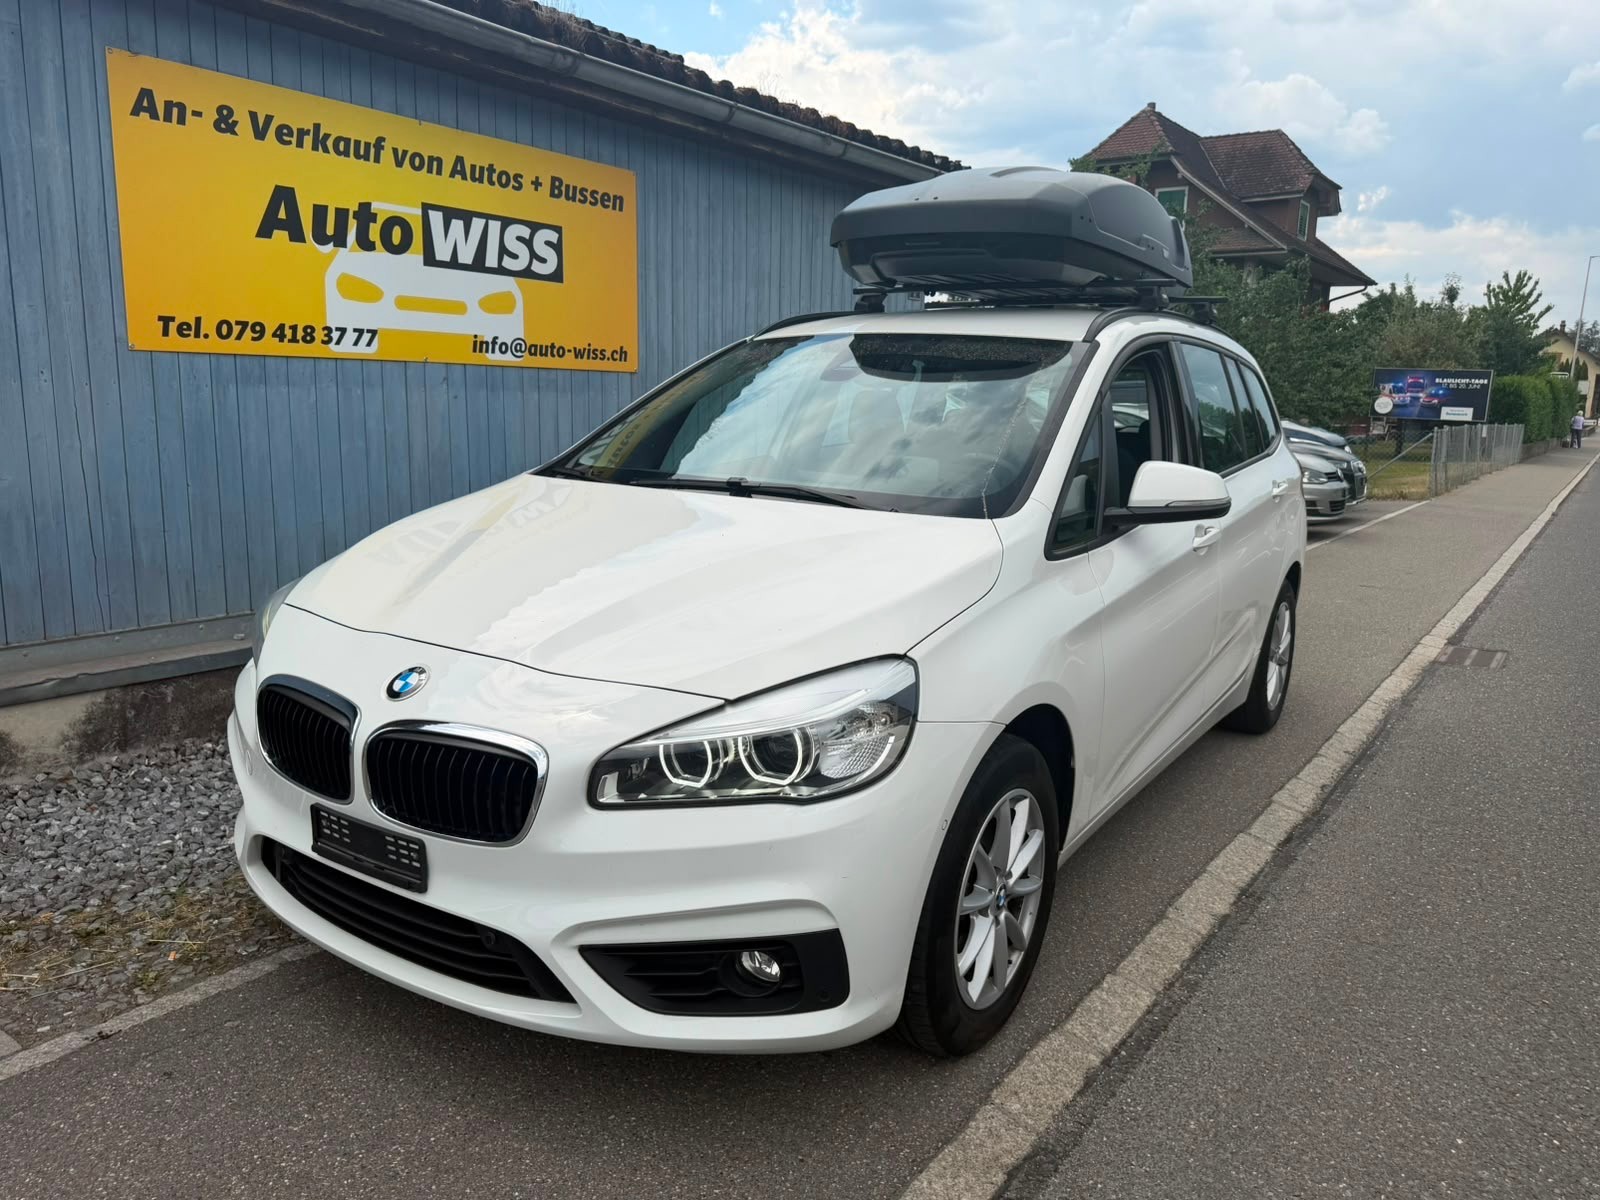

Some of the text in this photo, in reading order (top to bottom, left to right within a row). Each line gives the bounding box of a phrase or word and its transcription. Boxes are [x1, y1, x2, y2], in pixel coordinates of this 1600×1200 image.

[129, 86, 624, 212] An- & Verkauf von Autos + Bussen
[255, 184, 560, 276] Auto WISS
[157, 315, 378, 347] Tel. 079 418 37 77
[472, 334, 628, 362] info@auto-wiss.ch
